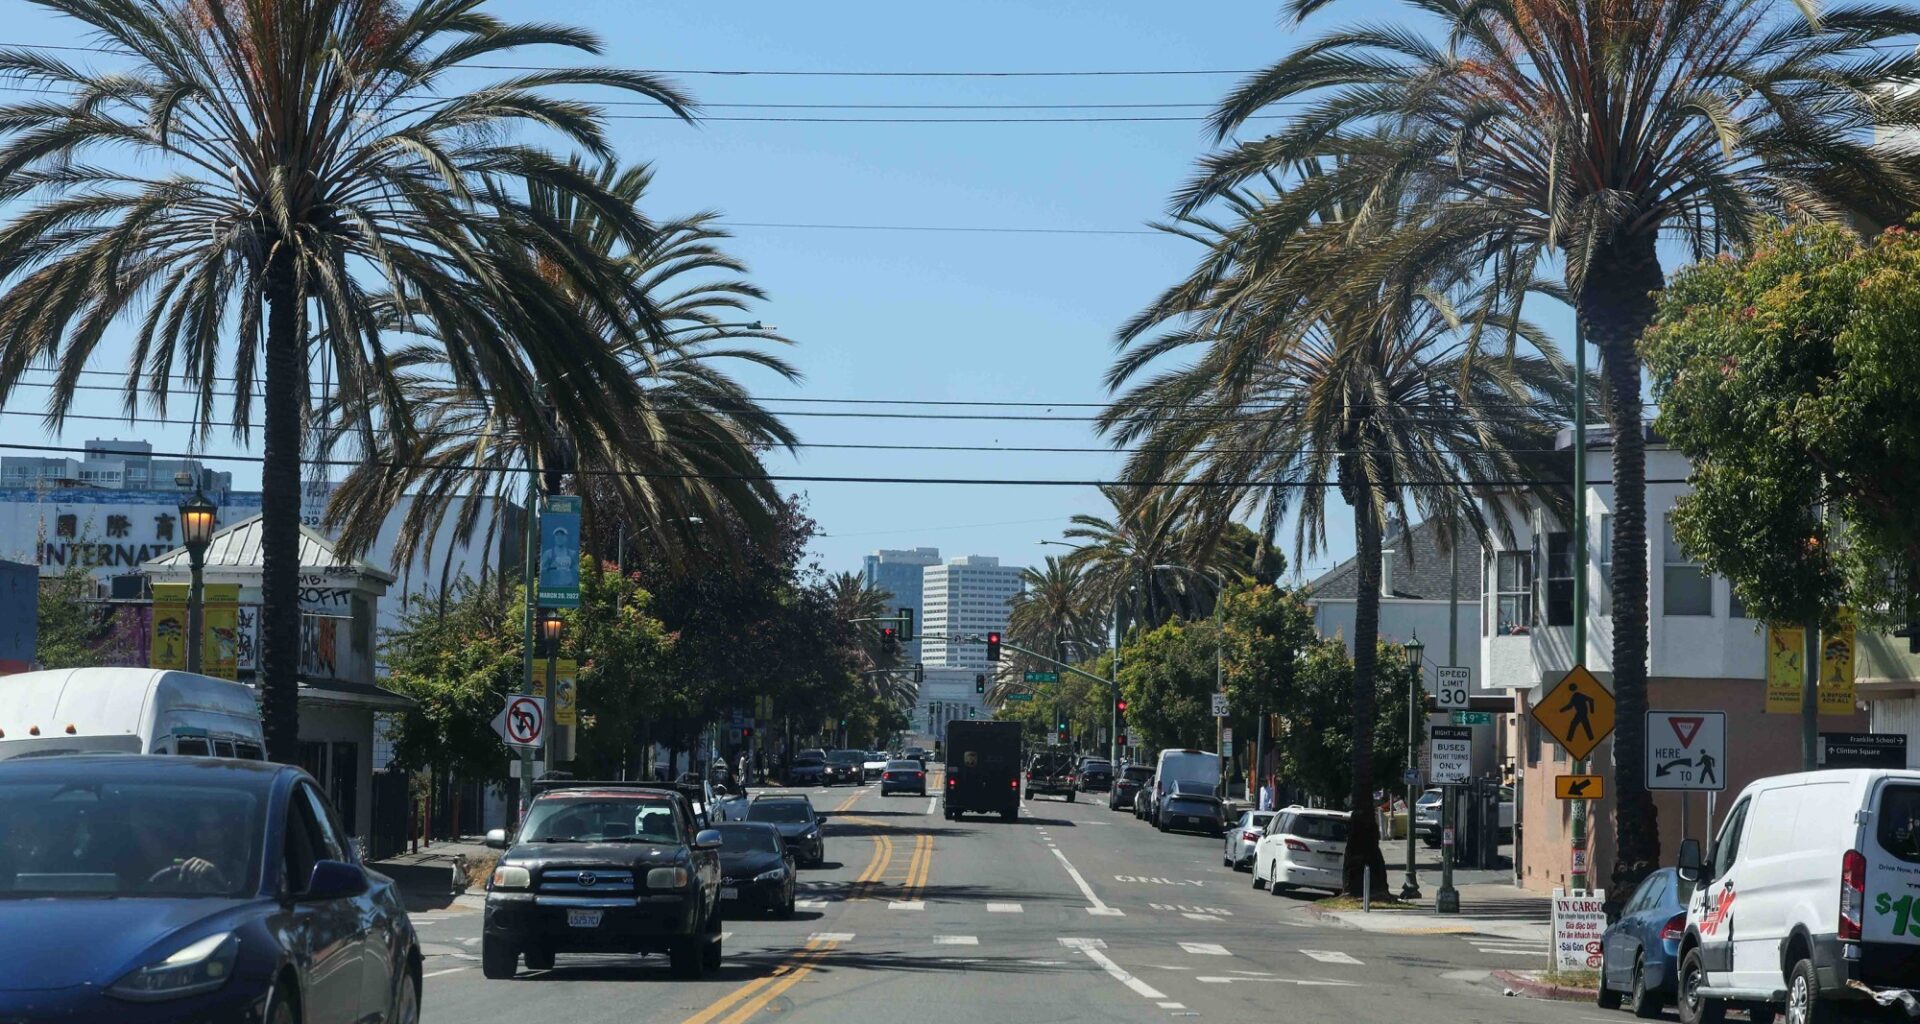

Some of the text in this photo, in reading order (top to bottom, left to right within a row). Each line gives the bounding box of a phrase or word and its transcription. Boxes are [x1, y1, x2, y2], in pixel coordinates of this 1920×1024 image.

[1440, 670, 1468, 678] SPEED
[1440, 689, 1466, 704] 30
[1214, 705, 1229, 715] 30
[1437, 743, 1466, 751] BUSES
[1859, 748, 1881, 756] Square
[1655, 748, 1681, 759] HERE
[1680, 771, 1692, 781] TO
[1878, 863, 1895, 871] Drive
[1114, 875, 1203, 887] ONLY
[1557, 901, 1569, 911] VN
